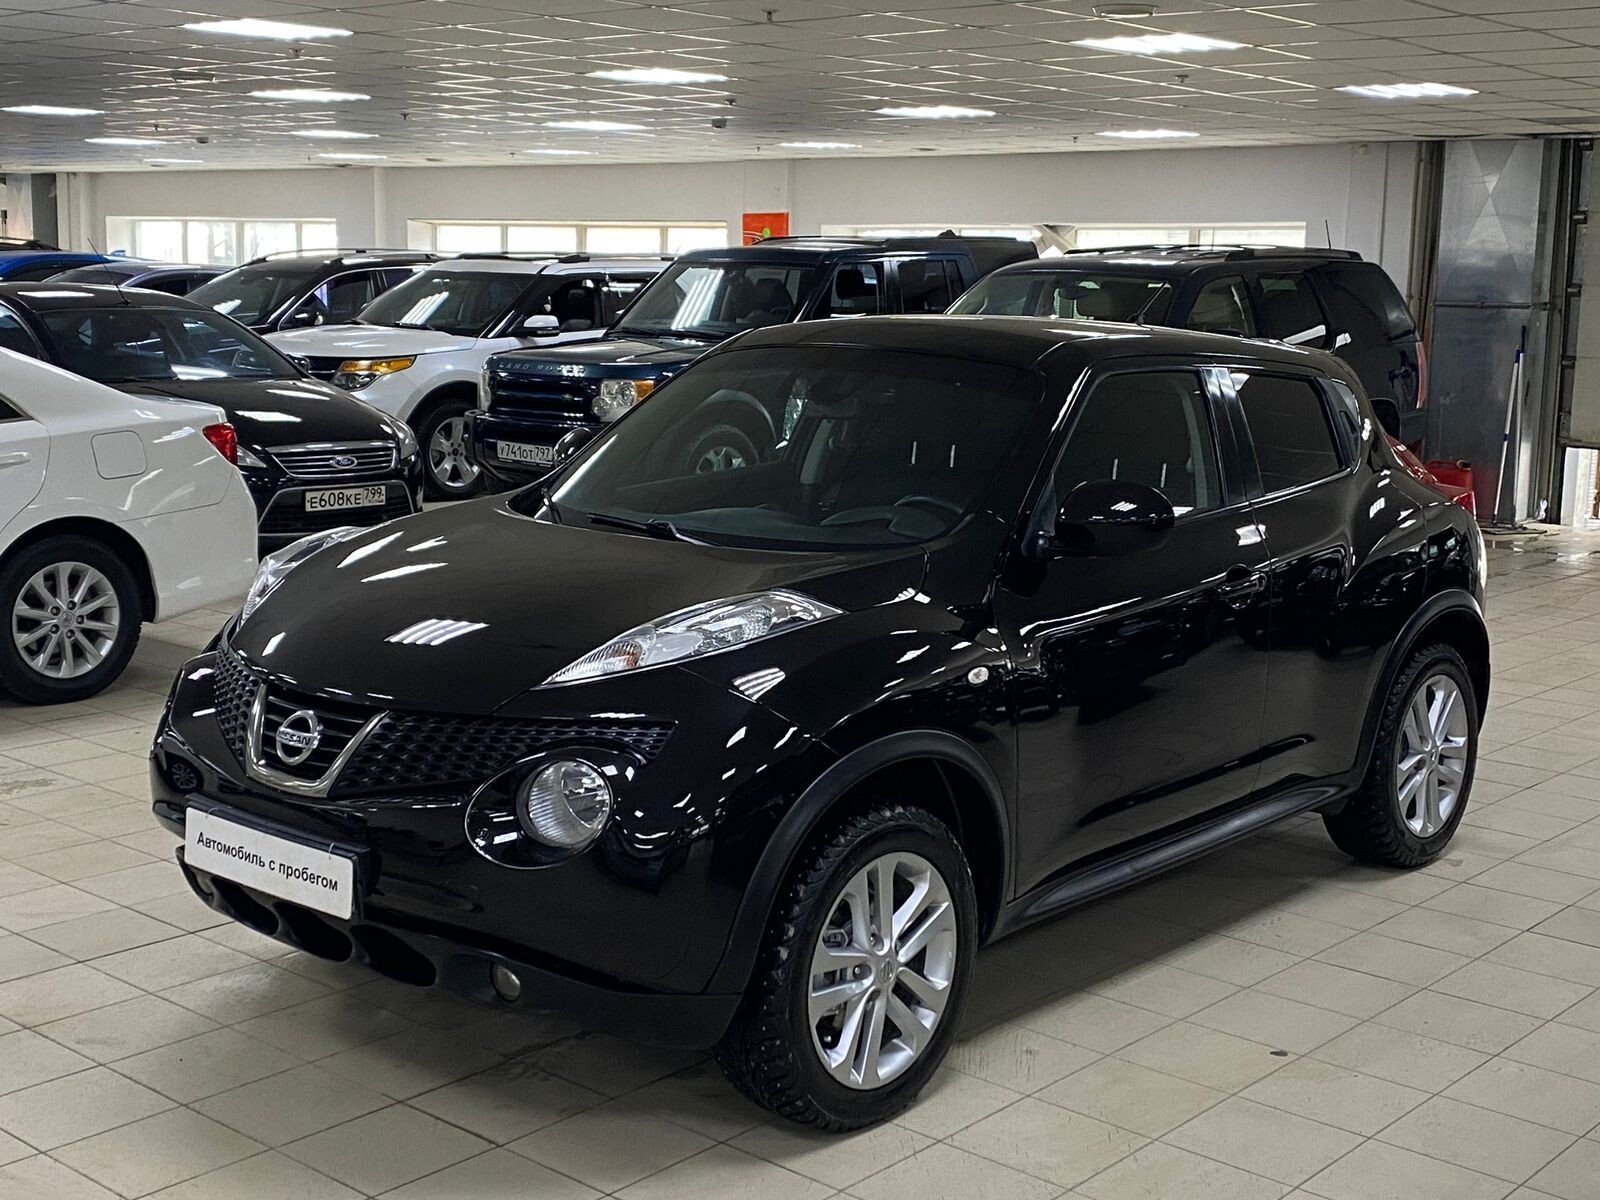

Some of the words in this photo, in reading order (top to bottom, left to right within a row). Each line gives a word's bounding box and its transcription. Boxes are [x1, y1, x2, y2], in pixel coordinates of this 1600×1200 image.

[499, 361, 530, 371] LAND
[280, 730, 312, 747] SSAN
[196, 831, 266, 868] Автомобиль
[268, 859, 276, 871] с
[278, 863, 339, 892] пробегом
